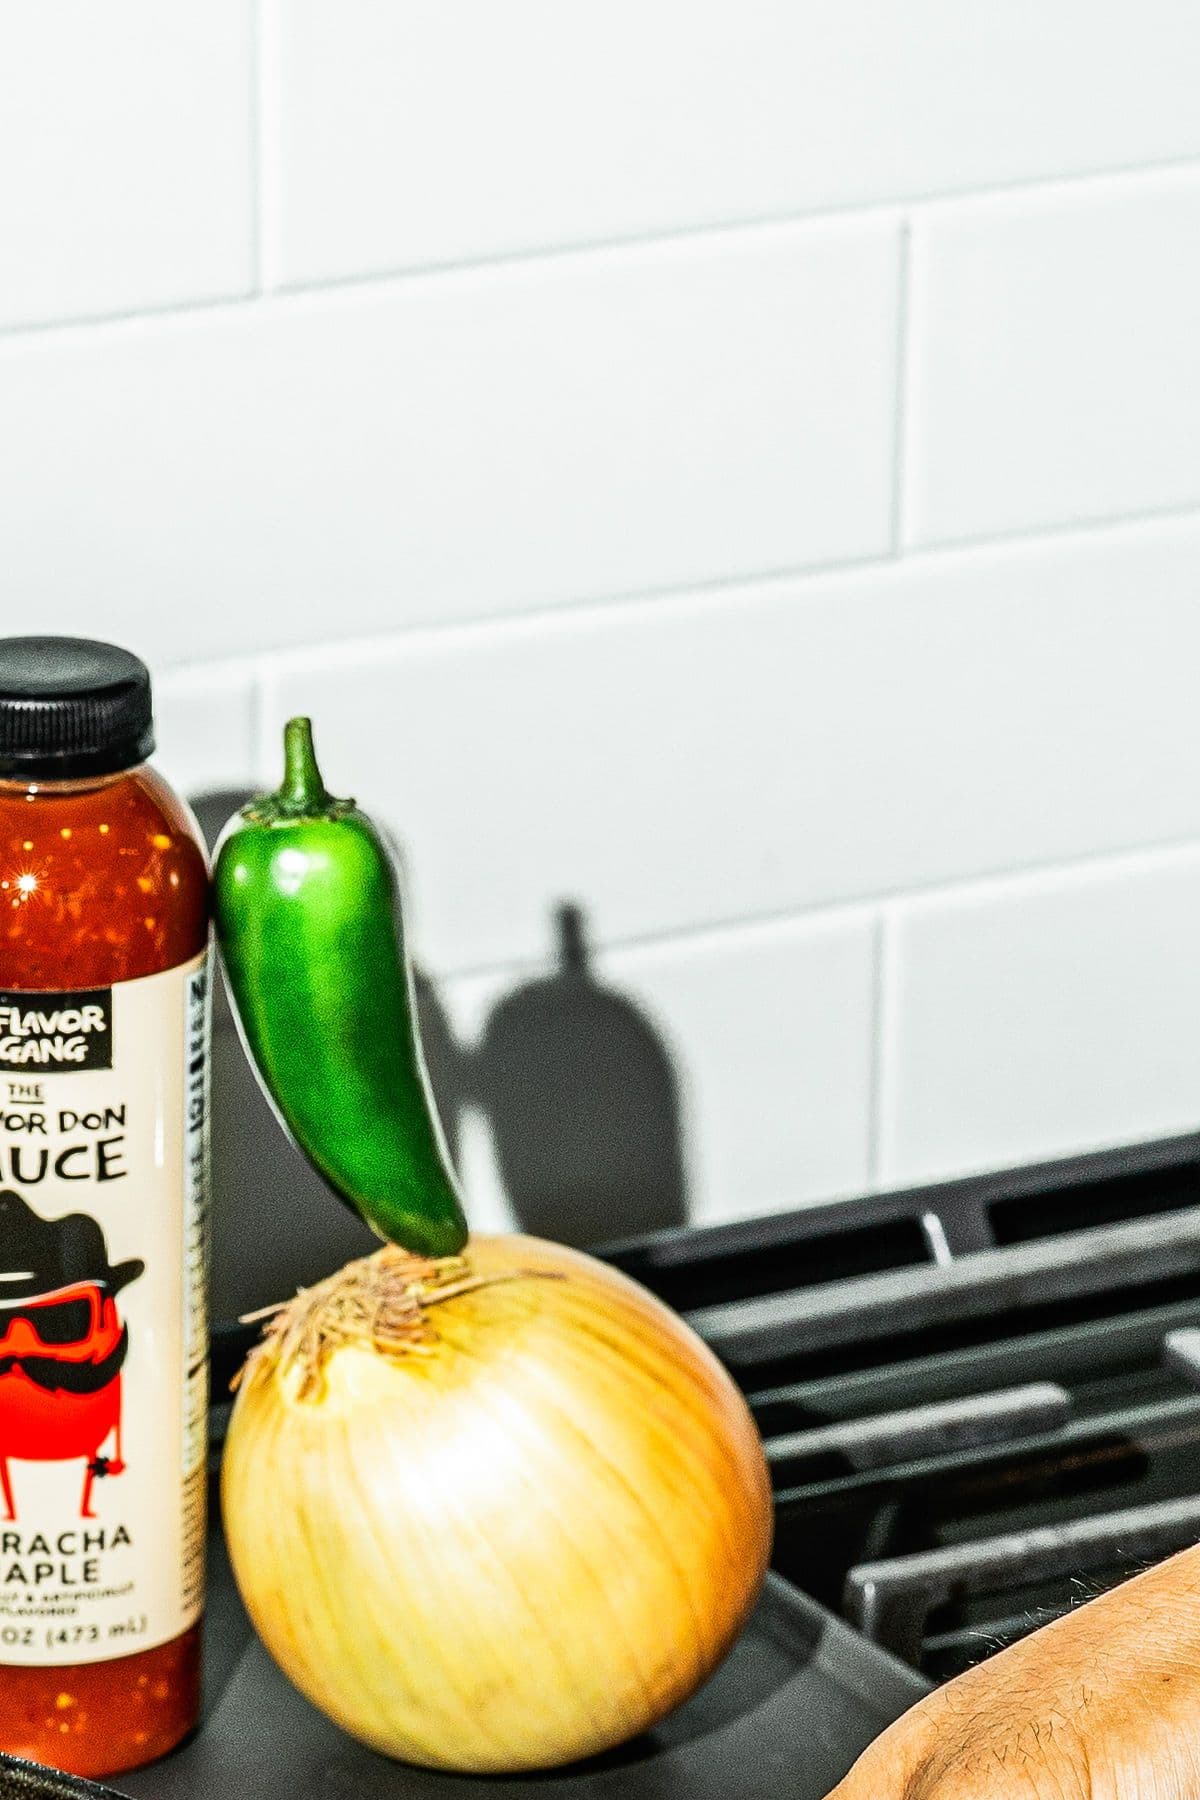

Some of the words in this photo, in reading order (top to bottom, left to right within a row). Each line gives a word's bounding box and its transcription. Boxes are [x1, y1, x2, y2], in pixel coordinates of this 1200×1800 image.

[9, 1084, 42, 1098] THE
[59, 1104, 126, 1132] DON
[0, 1627, 34, 1647] OZ
